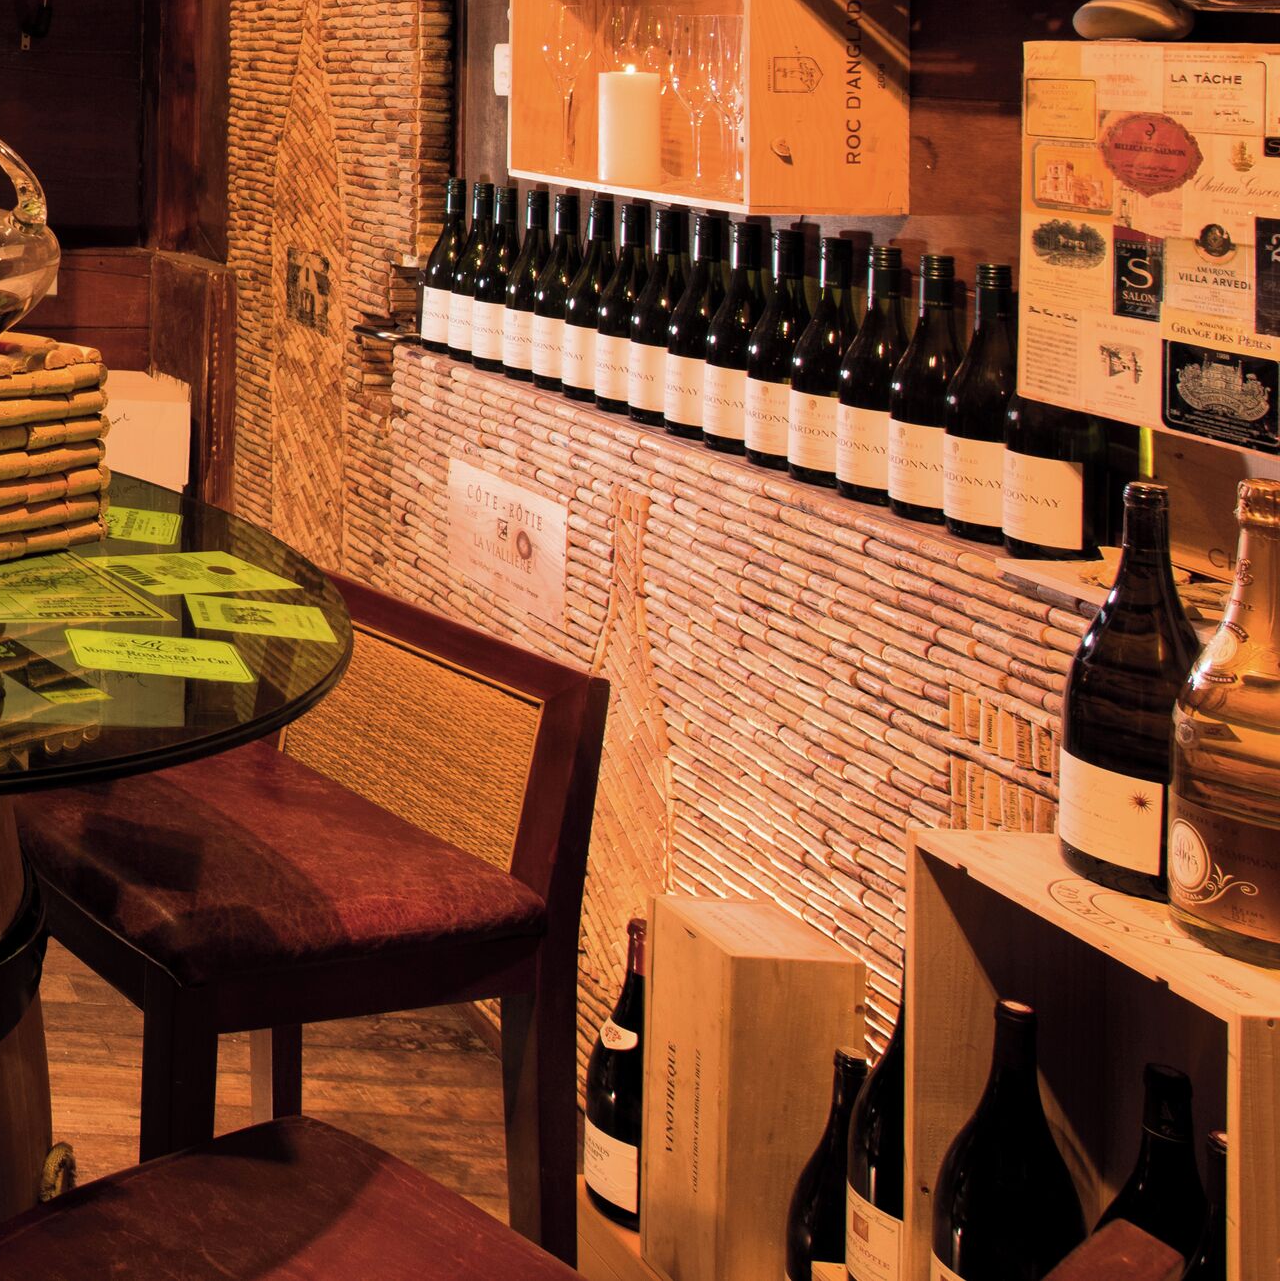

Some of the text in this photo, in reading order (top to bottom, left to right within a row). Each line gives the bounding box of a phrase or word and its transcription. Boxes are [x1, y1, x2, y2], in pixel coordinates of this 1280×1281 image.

[1170, 71, 1243, 85] LA TÂCHE
[846, 119, 862, 165] ROC
[1121, 256, 1154, 289] S
[1178, 272, 1253, 291] VILLA ARVEDI
[1195, 265, 1237, 278] AMARONE
[1122, 290, 1157, 303] SALON
[1171, 321, 1212, 341] GRANGE
[1215, 331, 1234, 344] DES
[474, 532, 484, 551] LA
[665, 1041, 677, 1153] VINOTHEQUE
[693, 1079, 701, 1135] CHAMPAGNE
[692, 1136, 700, 1194] COLLECTION
